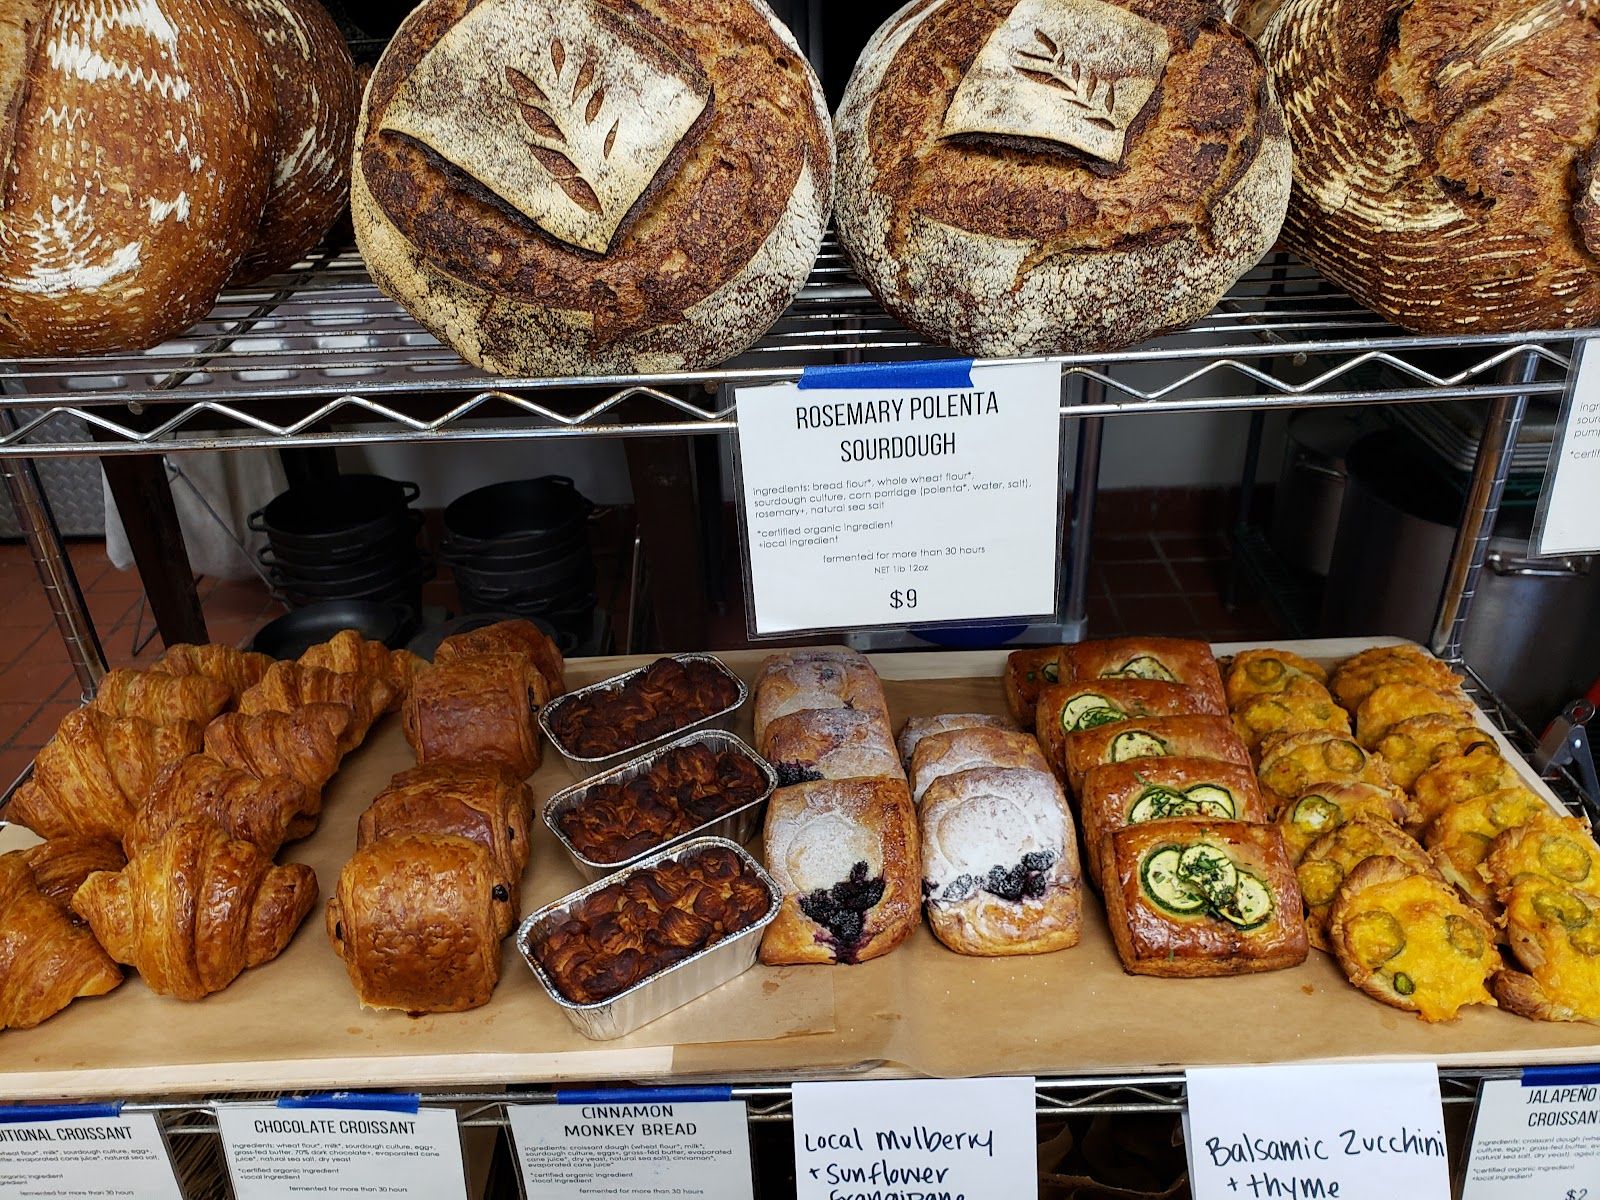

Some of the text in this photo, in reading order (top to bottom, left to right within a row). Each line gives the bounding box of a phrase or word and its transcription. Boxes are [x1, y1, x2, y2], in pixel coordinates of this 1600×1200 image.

[796, 391, 999, 430] ROSEMARY POLENTA
[840, 432, 956, 462] SOURDOUGH
[753, 483, 810, 497] ingredients:
[812, 480, 843, 491] bread
[877, 476, 908, 486] whole
[910, 473, 942, 484] wheat
[754, 495, 807, 507] sourdough
[809, 491, 846, 503] culture,
[849, 491, 872, 499] corn
[874, 487, 917, 500] porridge
[973, 481, 1005, 491] water,
[810, 503, 845, 514] natural
[868, 501, 885, 510] salt
[804, 524, 841, 538] organic
[844, 520, 894, 533] ingredient
[789, 535, 838, 547] ingredient
[823, 546, 986, 563] fermented for more than 30 hours
[874, 566, 890, 574] NET
[909, 564, 929, 573] 12oz
[890, 588, 917, 609] $9
[1526, 1085, 1598, 1104] JALAPEÑO
[582, 1104, 674, 1119] CINNAMON
[56, 1126, 132, 1141] CROISSANT
[254, 1120, 415, 1134] CHOCOLATE CROISSANT
[564, 1122, 697, 1137] MONKEY BREAD
[805, 1127, 864, 1152] Local
[1205, 1126, 1446, 1167] Balsamic Zucchini
[826, 1159, 950, 1187] Sunflower
[1246, 1172, 1339, 1200] thyme
